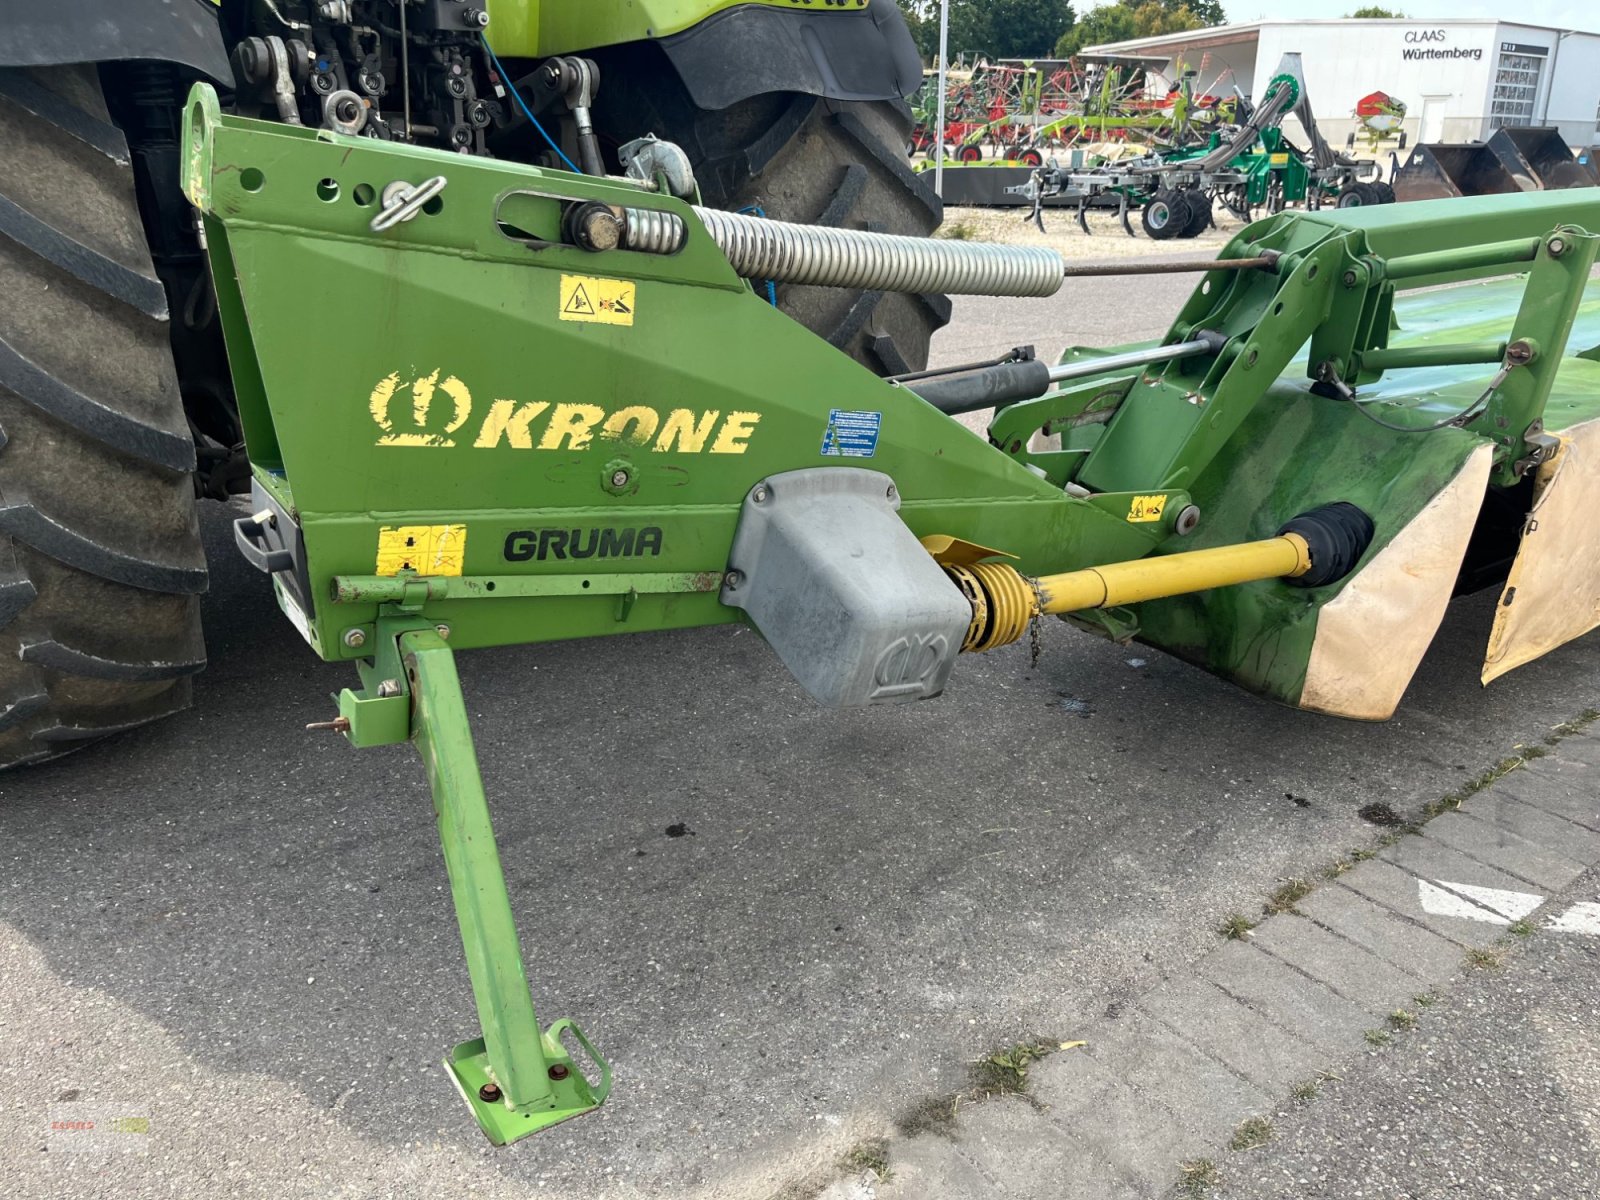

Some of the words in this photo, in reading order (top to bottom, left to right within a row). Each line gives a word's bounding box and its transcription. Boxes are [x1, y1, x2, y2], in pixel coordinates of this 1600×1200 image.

[1404, 29, 1446, 43] CLAAS
[1402, 47, 1482, 60] Württemberg
[473, 398, 762, 454] KRONE
[503, 527, 663, 562] GRUMA
